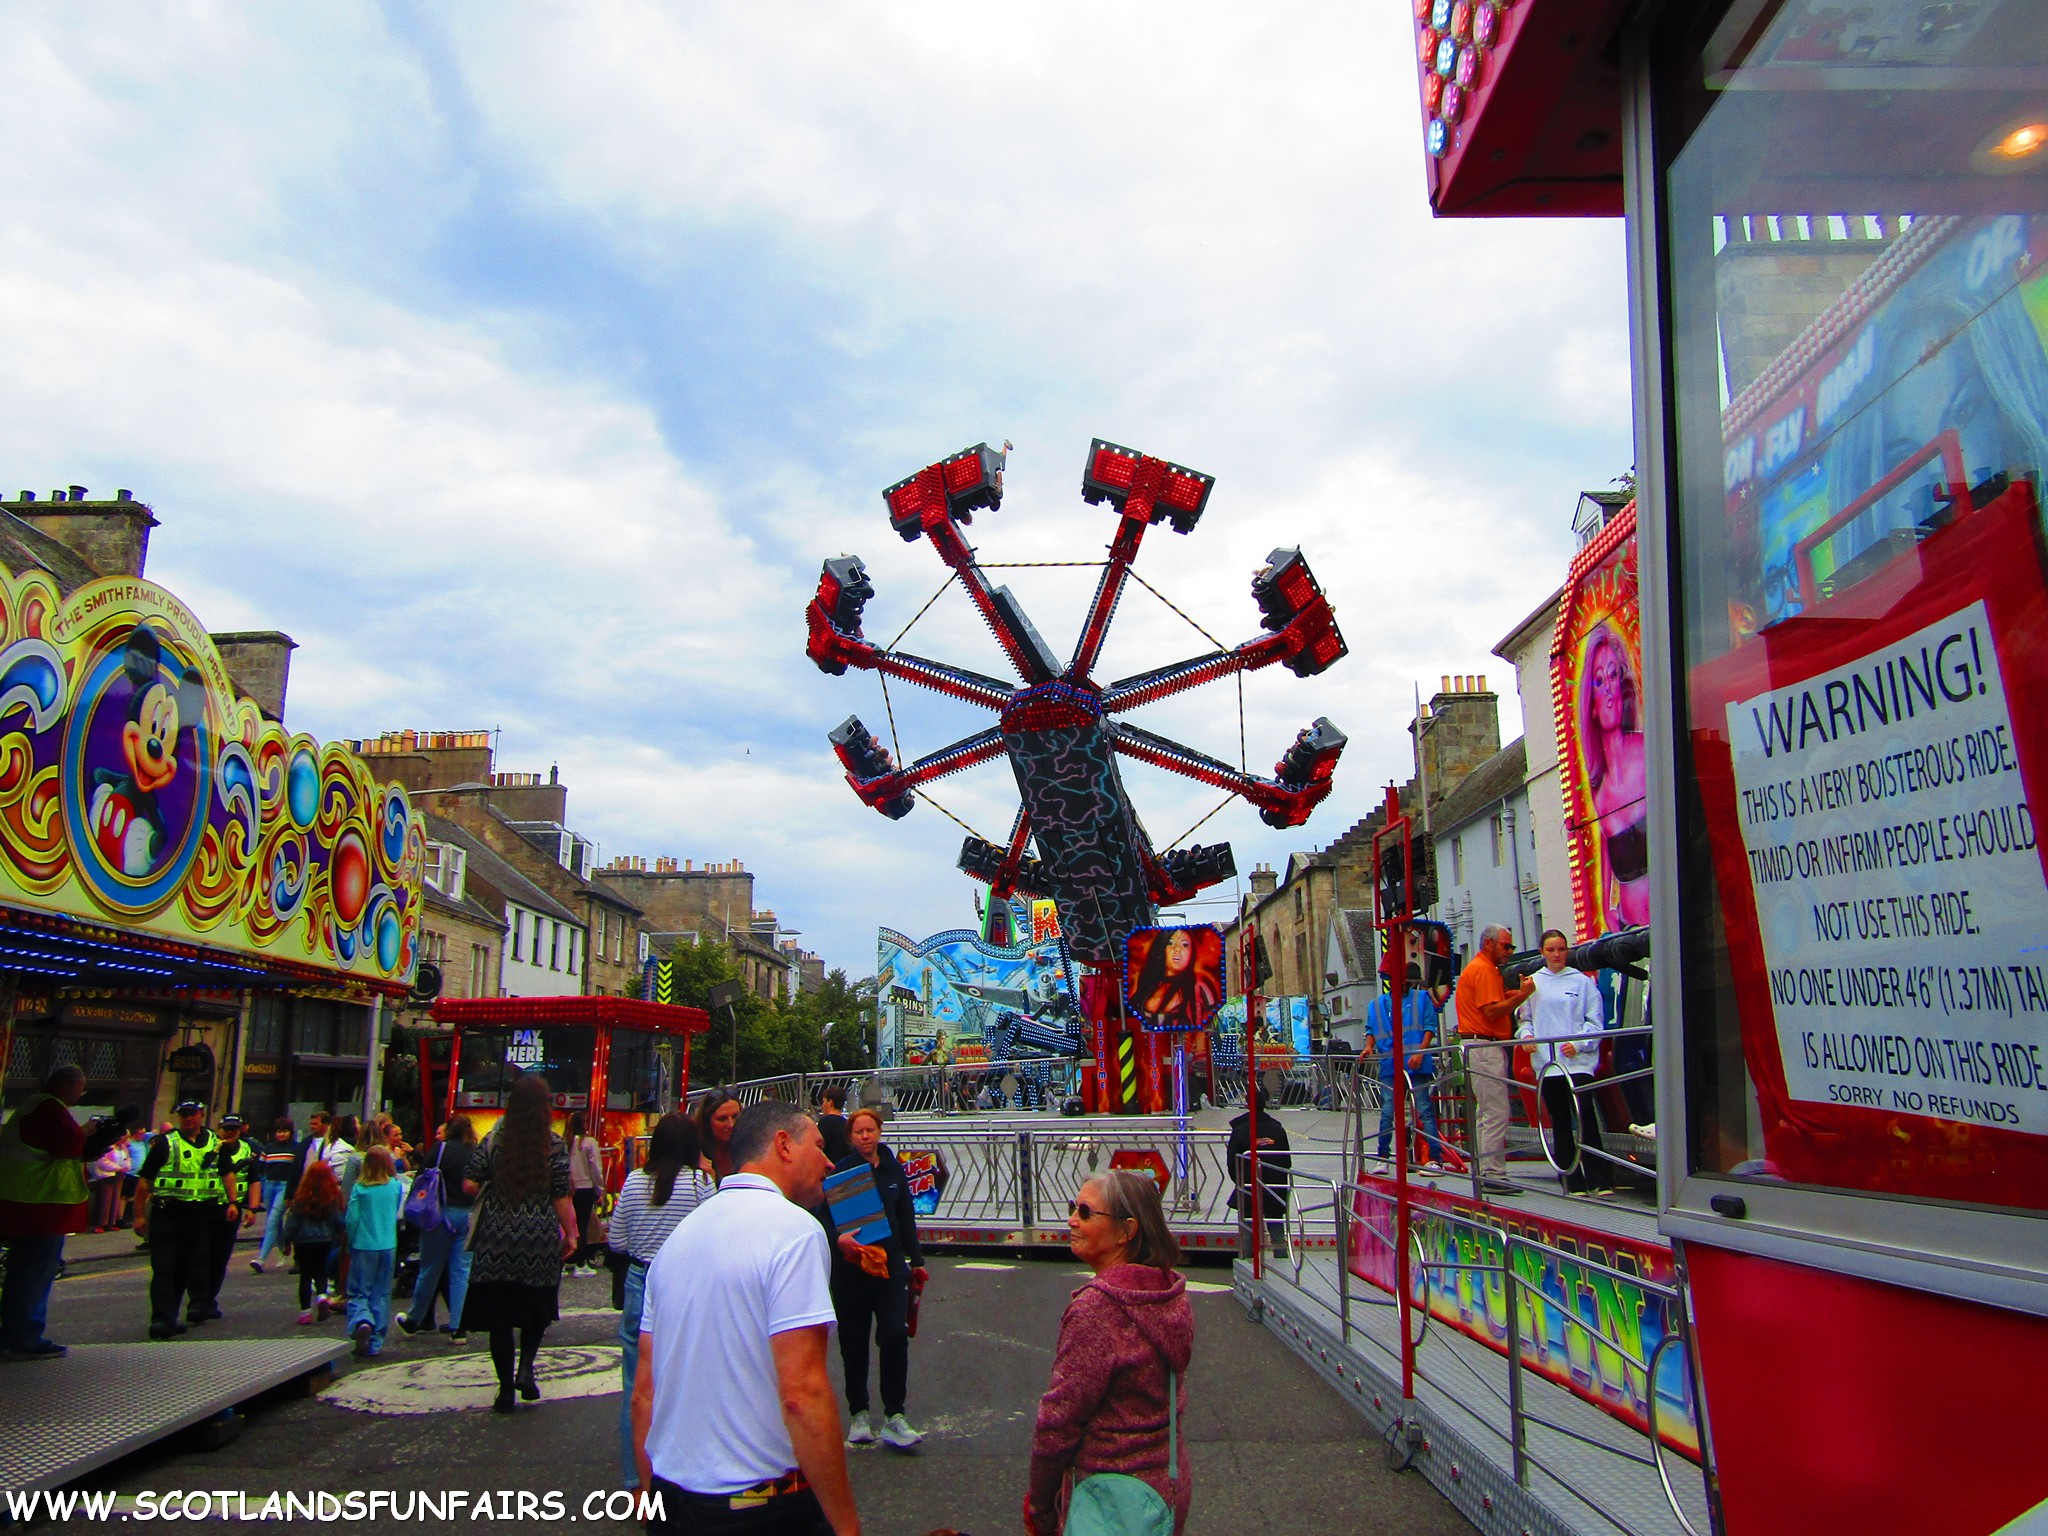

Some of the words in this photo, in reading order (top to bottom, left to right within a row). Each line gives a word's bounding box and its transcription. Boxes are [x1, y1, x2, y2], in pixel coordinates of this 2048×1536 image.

[55, 605, 84, 638] THE
[84, 586, 124, 613] SMITH
[126, 586, 166, 608] FAMILY
[166, 600, 208, 653] PROUDLY
[207, 652, 237, 729] PRESENT
[1752, 626, 1987, 759] WARNING!
[1742, 789, 1775, 824] THIS
[1778, 783, 1797, 818] IS
[1799, 780, 1811, 815] A
[1812, 770, 1855, 812] VERY
[1857, 739, 1964, 805] BOISTEROUS
[1965, 725, 2018, 777] RIDE.
[1748, 845, 1794, 885] TIMID
[1796, 840, 1821, 879] OR
[1822, 831, 1883, 877] INFIRM
[1885, 817, 1952, 868] PEOPLE
[1953, 802, 2036, 859] SHOULD
[1813, 901, 1849, 942] NOT
[1853, 897, 1886, 939] USE
[1886, 896, 1929, 938] THIS
[1932, 890, 1980, 937] RIDE.
[888, 995, 923, 1012] CABINS
[1772, 968, 1796, 1005] NO
[1799, 967, 1835, 1006] ONE
[1838, 967, 1902, 1008] UNDER
[1937, 965, 2013, 1019] (1.37M)
[506, 1046, 544, 1062] HERE
[513, 1030, 542, 1045] PAY
[1097, 1020, 1106, 1089] EXTREME
[1803, 1032, 1820, 1069] IS
[1823, 1032, 1912, 1075] ALLOWED
[1913, 1035, 1944, 1078] ON
[1943, 1038, 1991, 1084] THIS
[1828, 1083, 1883, 1106] SORRY
[1893, 1090, 1923, 1112] NO
[1929, 1092, 2020, 1125] REFUNDS
[902, 1153, 937, 1178] UPER
[917, 1230, 981, 1242] CTIONS
